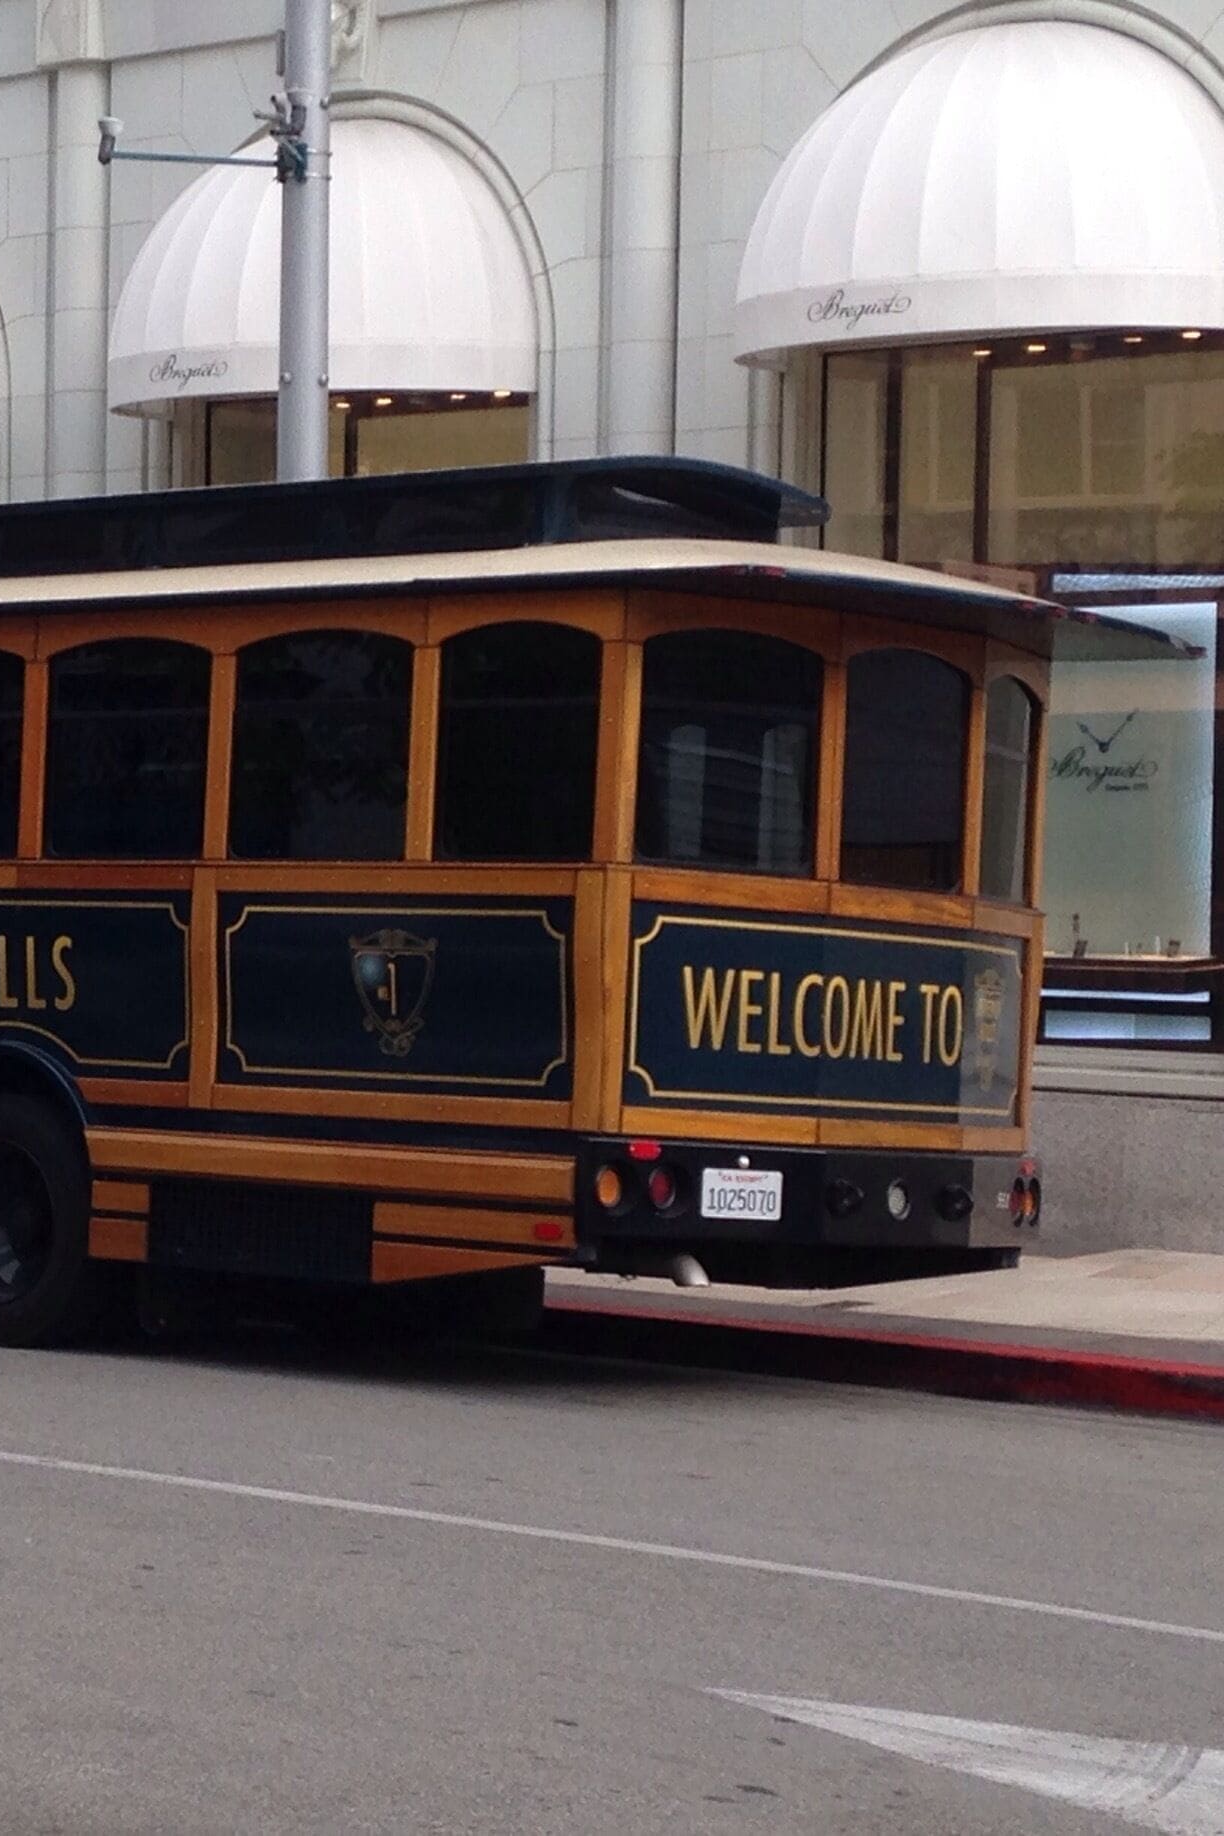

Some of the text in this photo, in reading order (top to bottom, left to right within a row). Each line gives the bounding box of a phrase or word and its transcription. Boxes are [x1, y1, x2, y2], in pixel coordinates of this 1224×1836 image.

[683, 965, 964, 1067] WELCOME TO
[707, 1187, 777, 1213] 1025070
